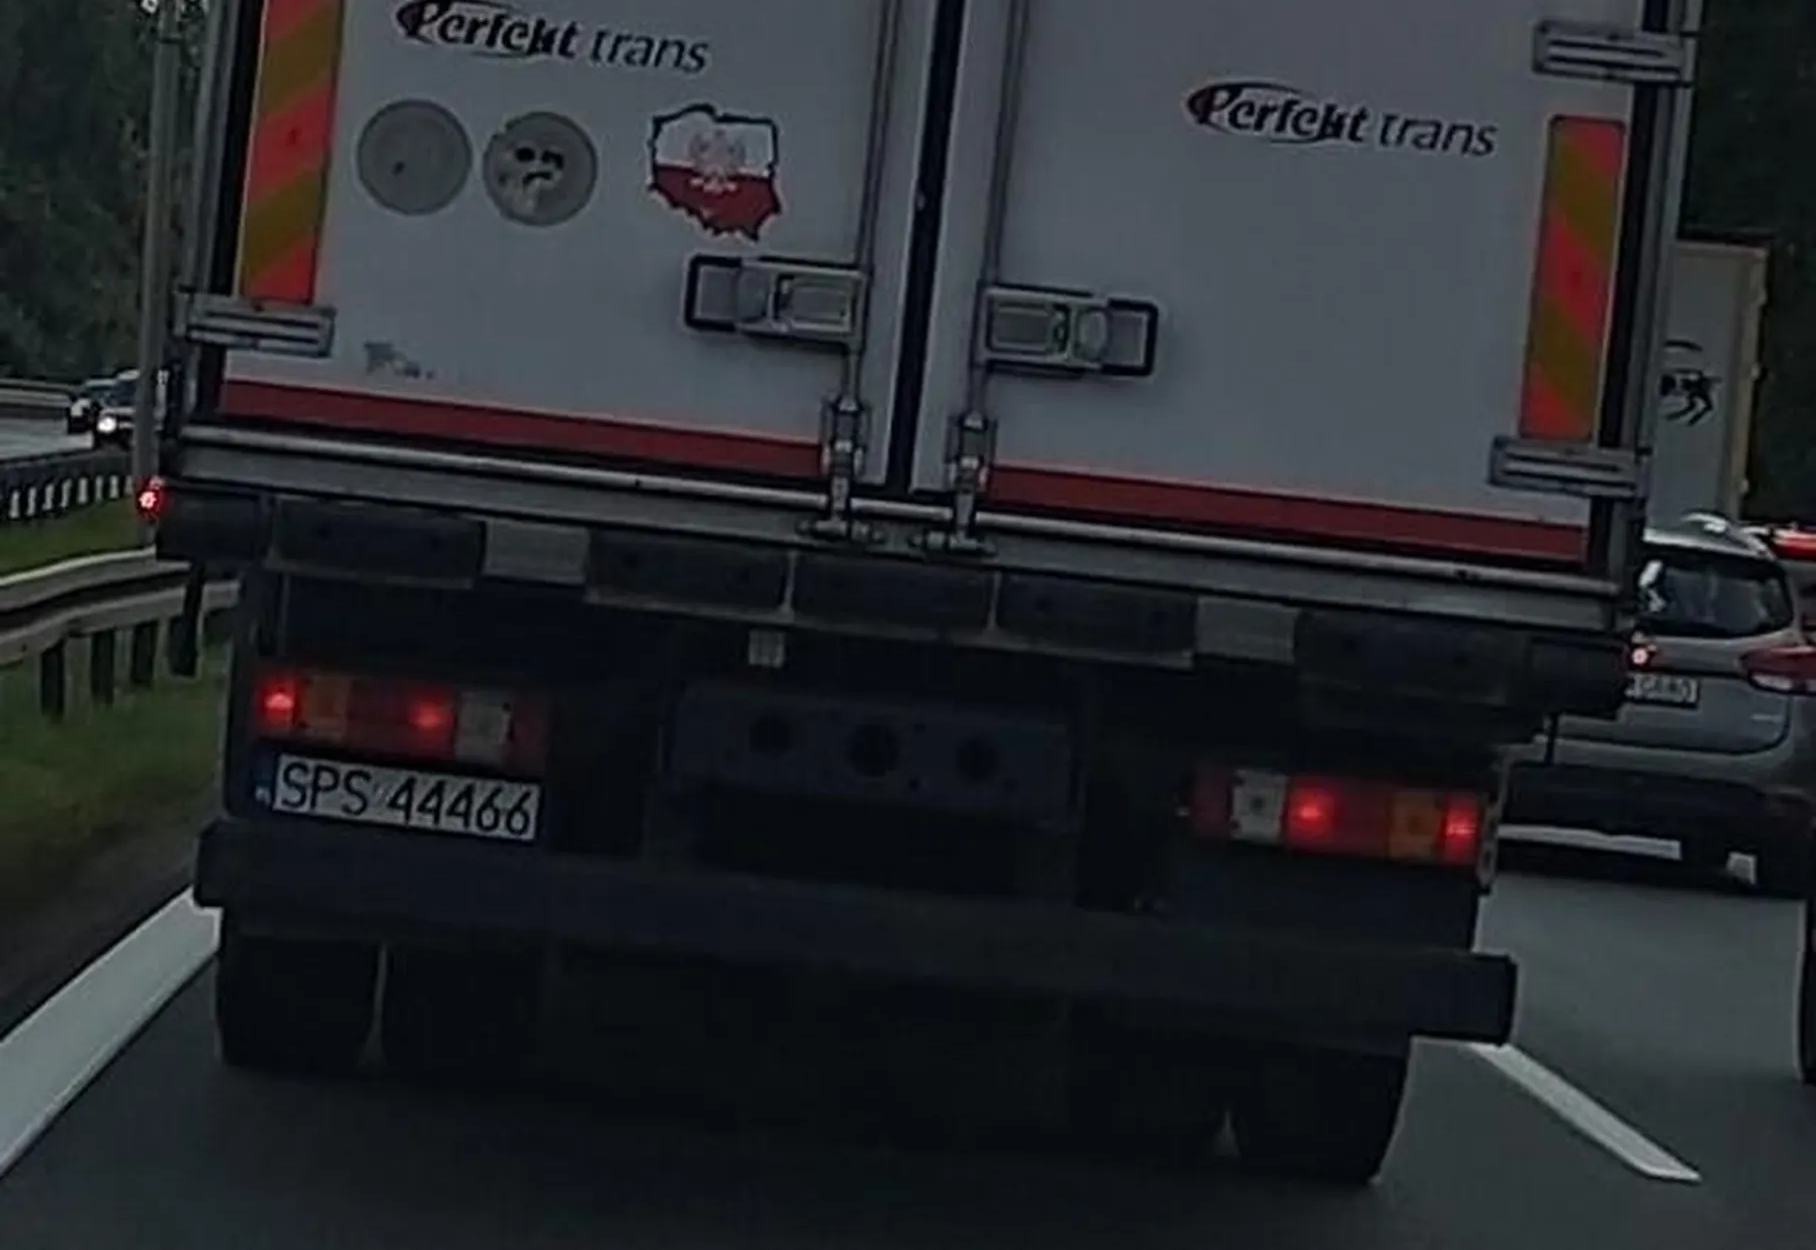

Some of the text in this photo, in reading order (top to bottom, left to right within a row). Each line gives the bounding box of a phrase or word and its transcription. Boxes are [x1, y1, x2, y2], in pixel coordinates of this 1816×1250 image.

[591, 29, 710, 72] trans
[1187, 81, 1498, 156] Perfekt trans
[283, 762, 532, 835] SPS 44466
